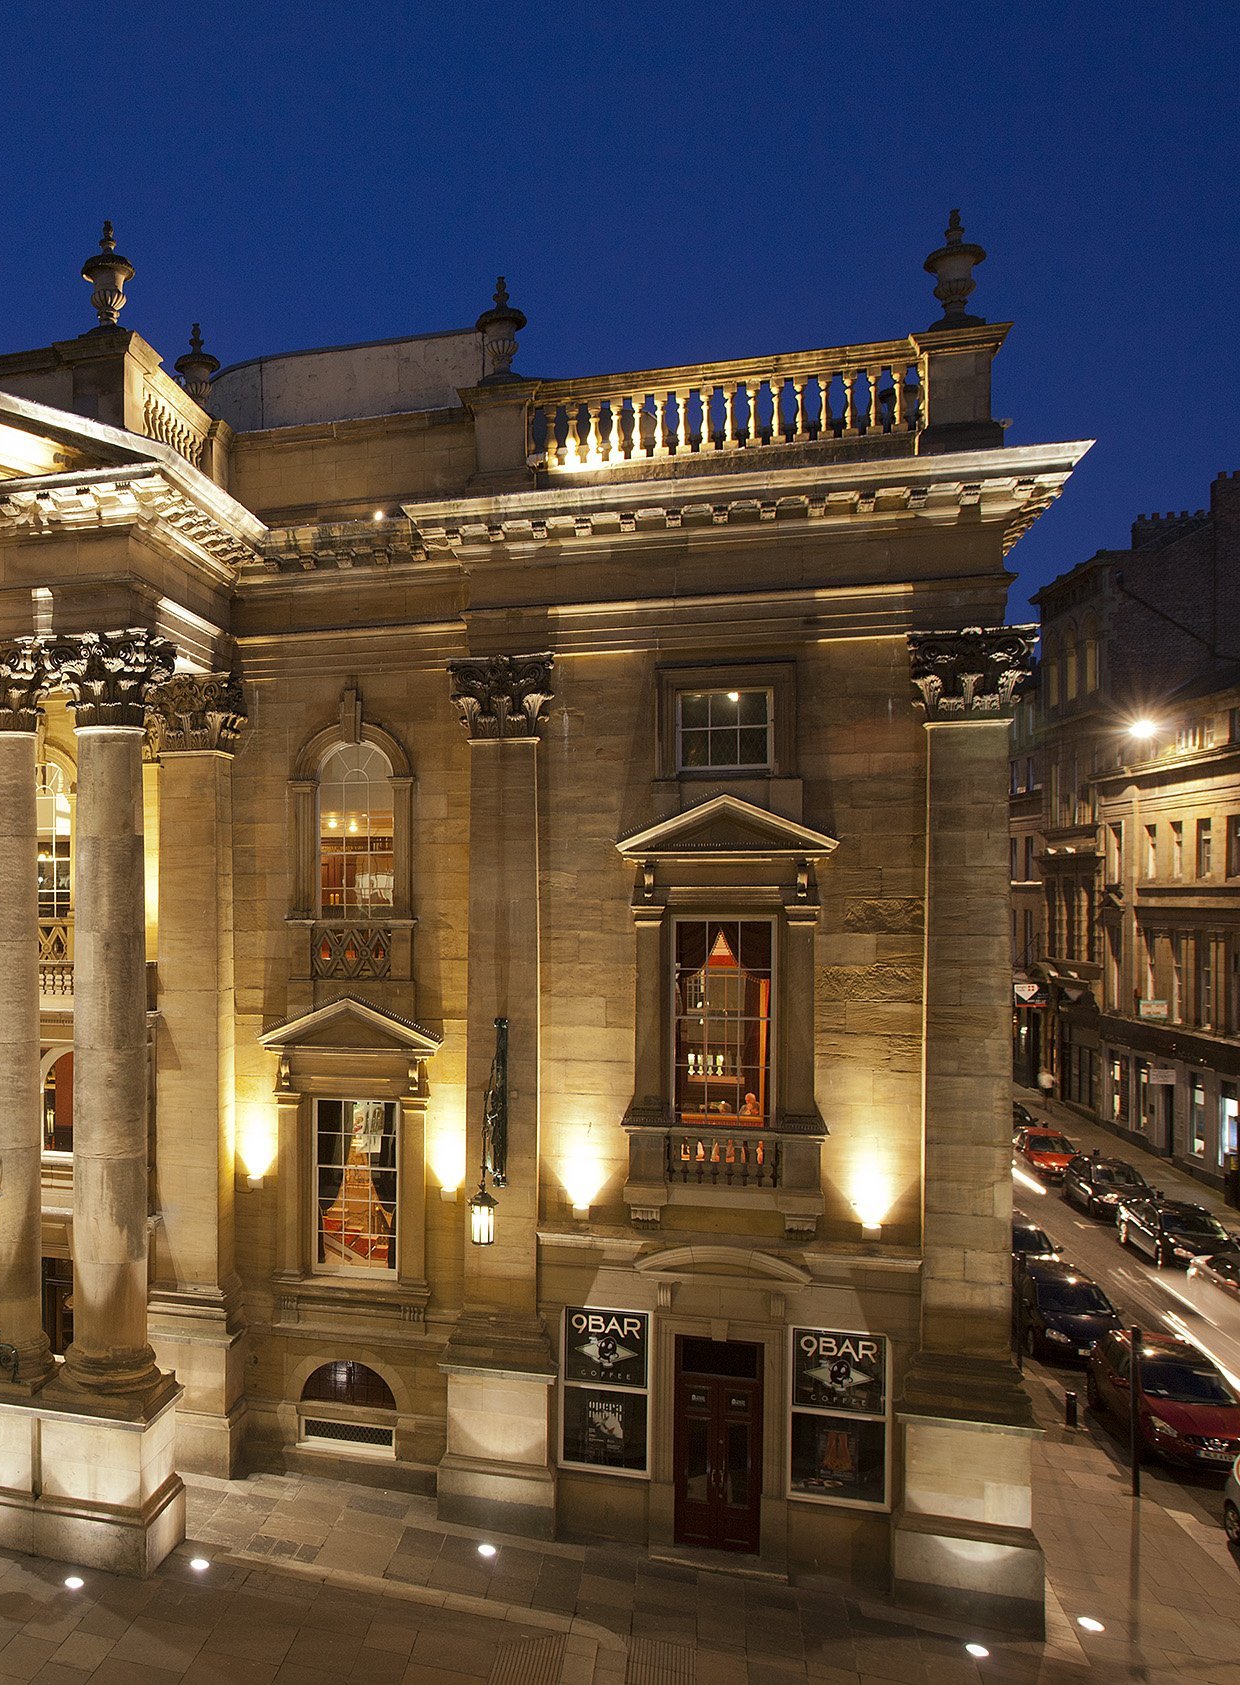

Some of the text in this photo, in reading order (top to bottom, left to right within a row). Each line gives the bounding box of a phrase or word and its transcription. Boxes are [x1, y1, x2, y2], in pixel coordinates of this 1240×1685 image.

[571, 1313, 641, 1340] 9BAR
[801, 1335, 878, 1363] 9BAR
[580, 1369, 632, 1381] COFFEE
[811, 1393, 867, 1407] COFFEE
